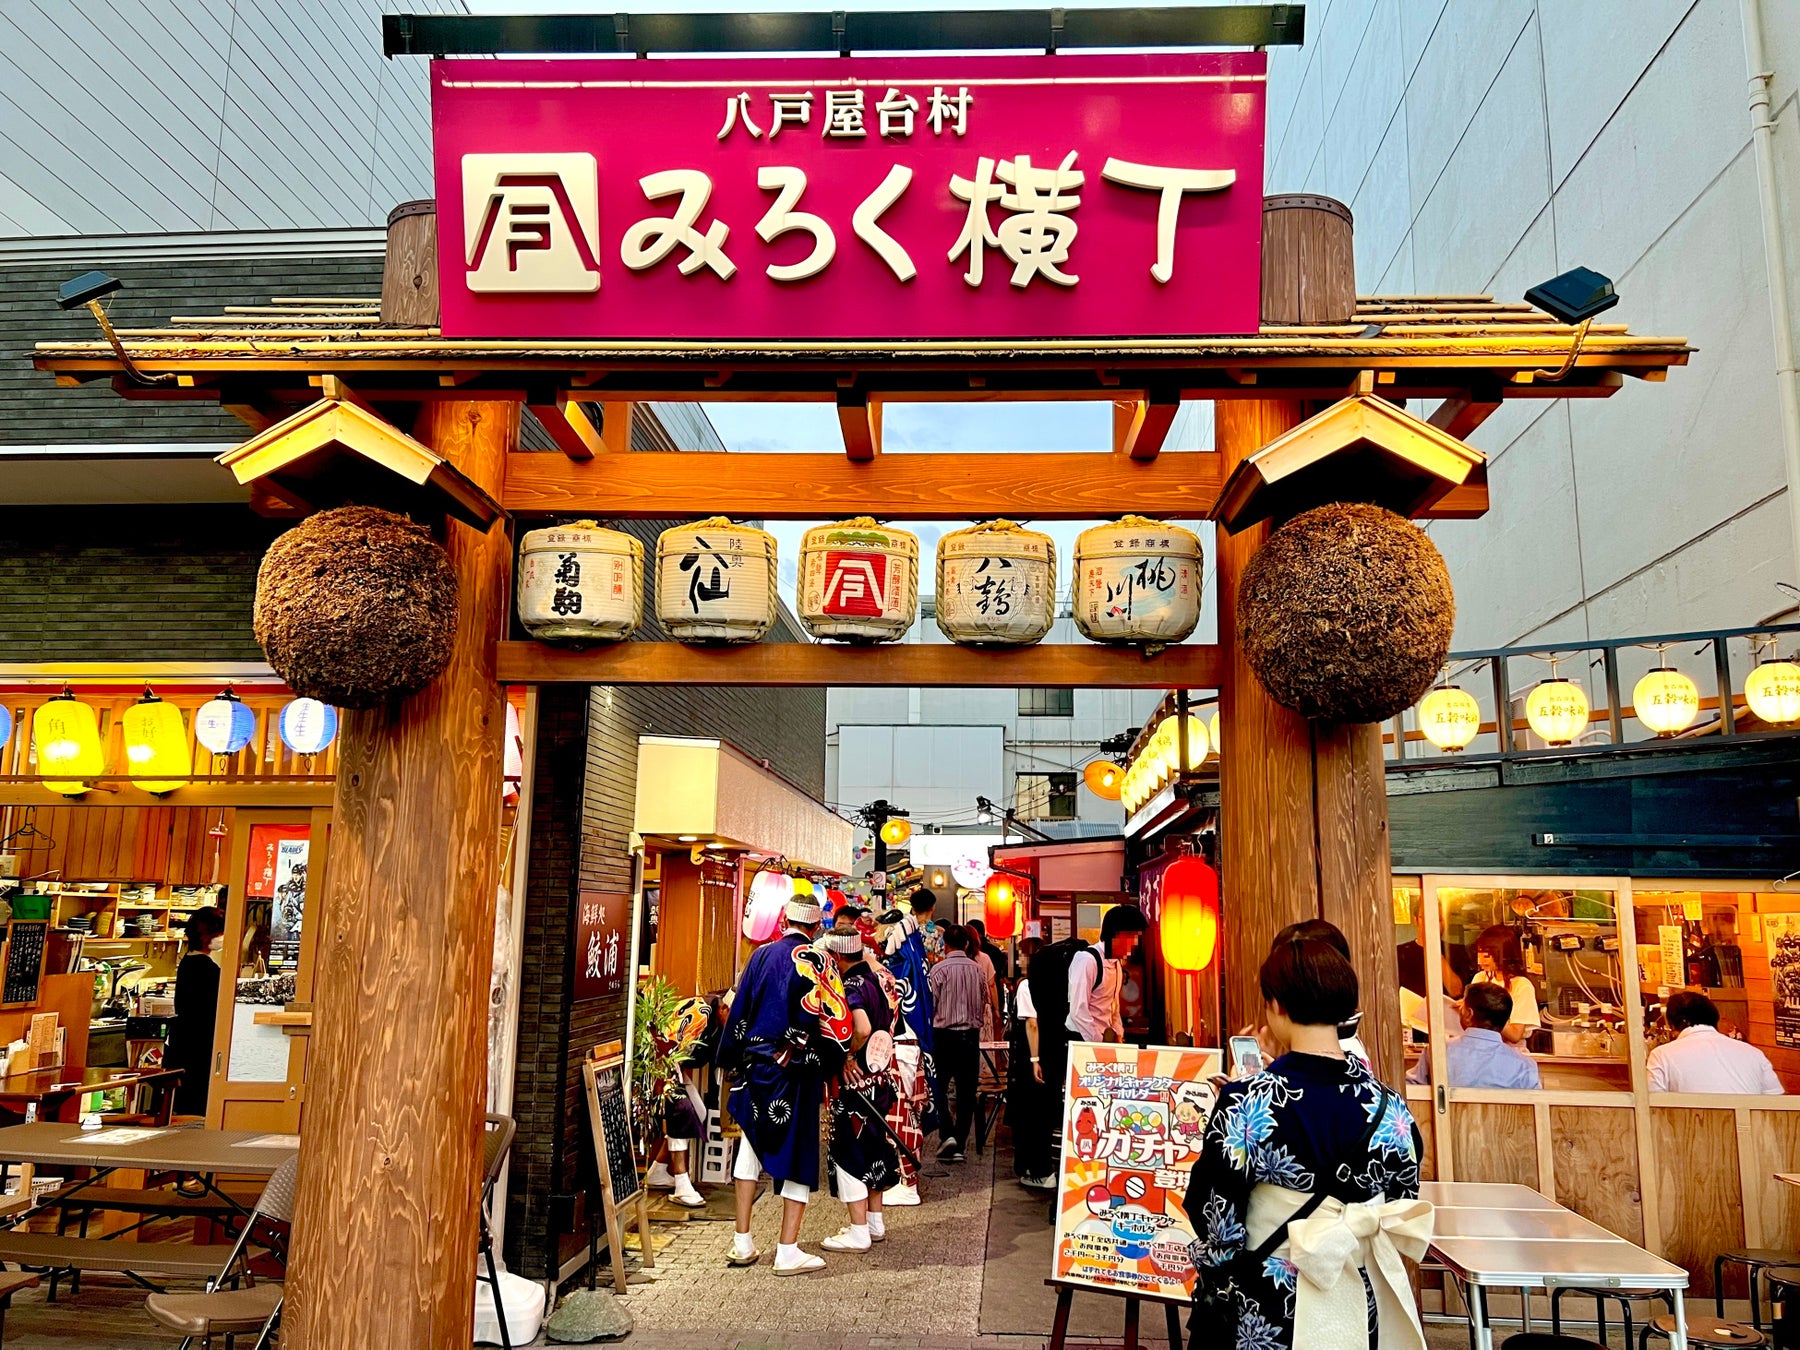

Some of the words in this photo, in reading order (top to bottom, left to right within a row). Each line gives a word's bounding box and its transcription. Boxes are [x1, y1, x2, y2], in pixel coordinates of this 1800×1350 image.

[716, 86, 974, 140] 八戸屋台村
[619, 149, 1238, 289] みろく横丁
[1086, 1062, 1137, 1074] みろく横丁
[1078, 1075, 1181, 1090] オリジナルキャラクター
[1096, 1127, 1191, 1166] ガチャ
[1099, 1208, 1183, 1226] みろく横丁キャラクター
[1116, 1221, 1163, 1234] キーホルダー
